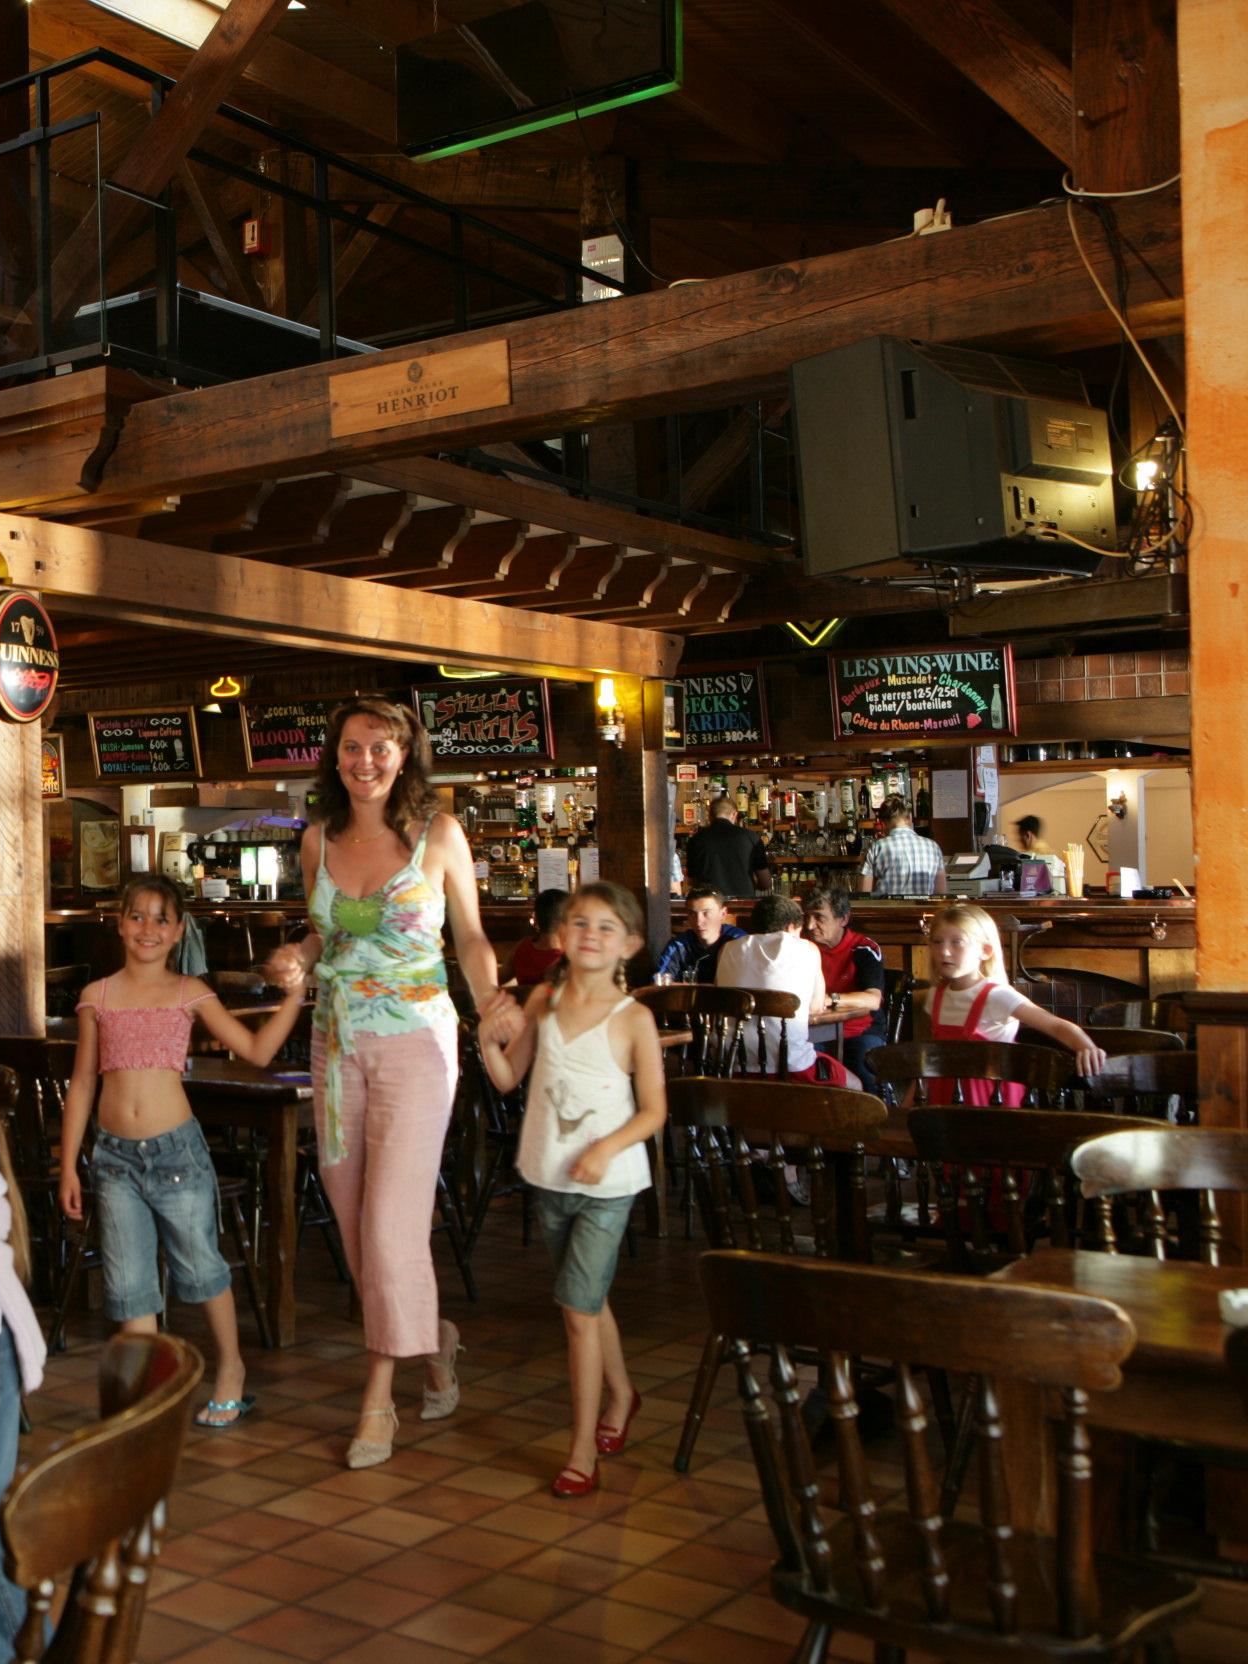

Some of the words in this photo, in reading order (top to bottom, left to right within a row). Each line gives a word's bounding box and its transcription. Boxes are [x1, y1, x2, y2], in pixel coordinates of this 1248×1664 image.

[377, 385, 460, 415] HENRIOT
[11, 621, 20, 633] 17
[842, 658, 880, 678] LES
[865, 691, 879, 703] les
[881, 691, 912, 702] verres
[887, 673, 932, 686] Muscadet
[938, 673, 989, 715] Chardonnay
[267, 705, 305, 719] COCKTAIL
[435, 689, 522, 727] STELLA
[297, 715, 328, 727] SPECIAL
[458, 710, 539, 746] ARTOIS
[687, 711, 753, 732] ARDEN
[880, 719, 890, 731] du
[252, 728, 306, 747] BLOODY
